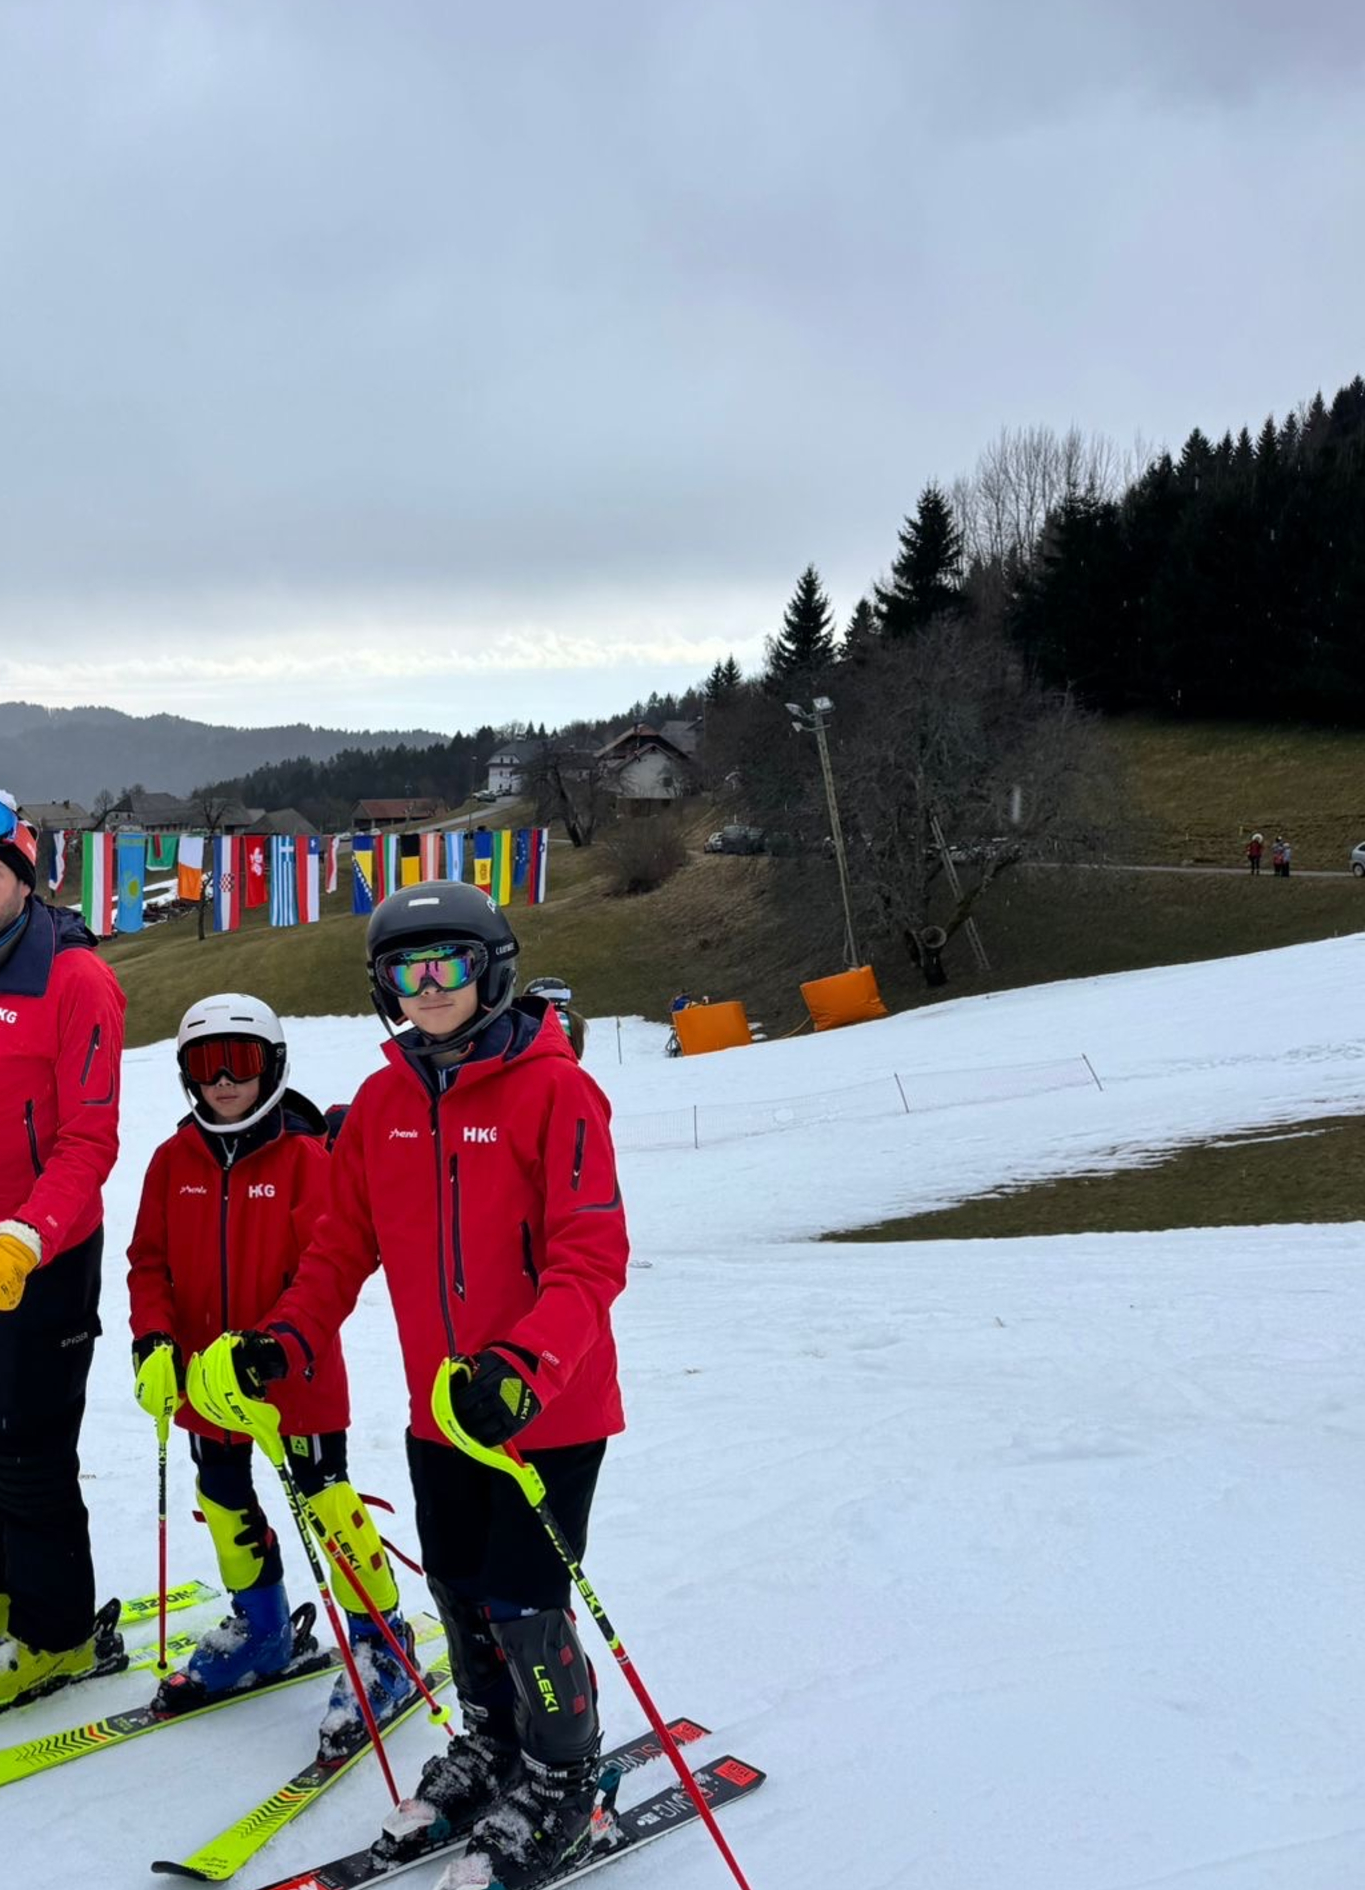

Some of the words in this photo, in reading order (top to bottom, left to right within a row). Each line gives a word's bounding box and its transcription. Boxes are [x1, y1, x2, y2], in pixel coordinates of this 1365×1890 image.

[248, 1183, 276, 1199] HKG
[225, 1391, 254, 1426] LEKI
[520, 1388, 532, 1420] LEKI
[334, 1530, 361, 1572] LEKI
[568, 1561, 604, 1619] LEKI
[533, 1665, 560, 1713] LEKI
